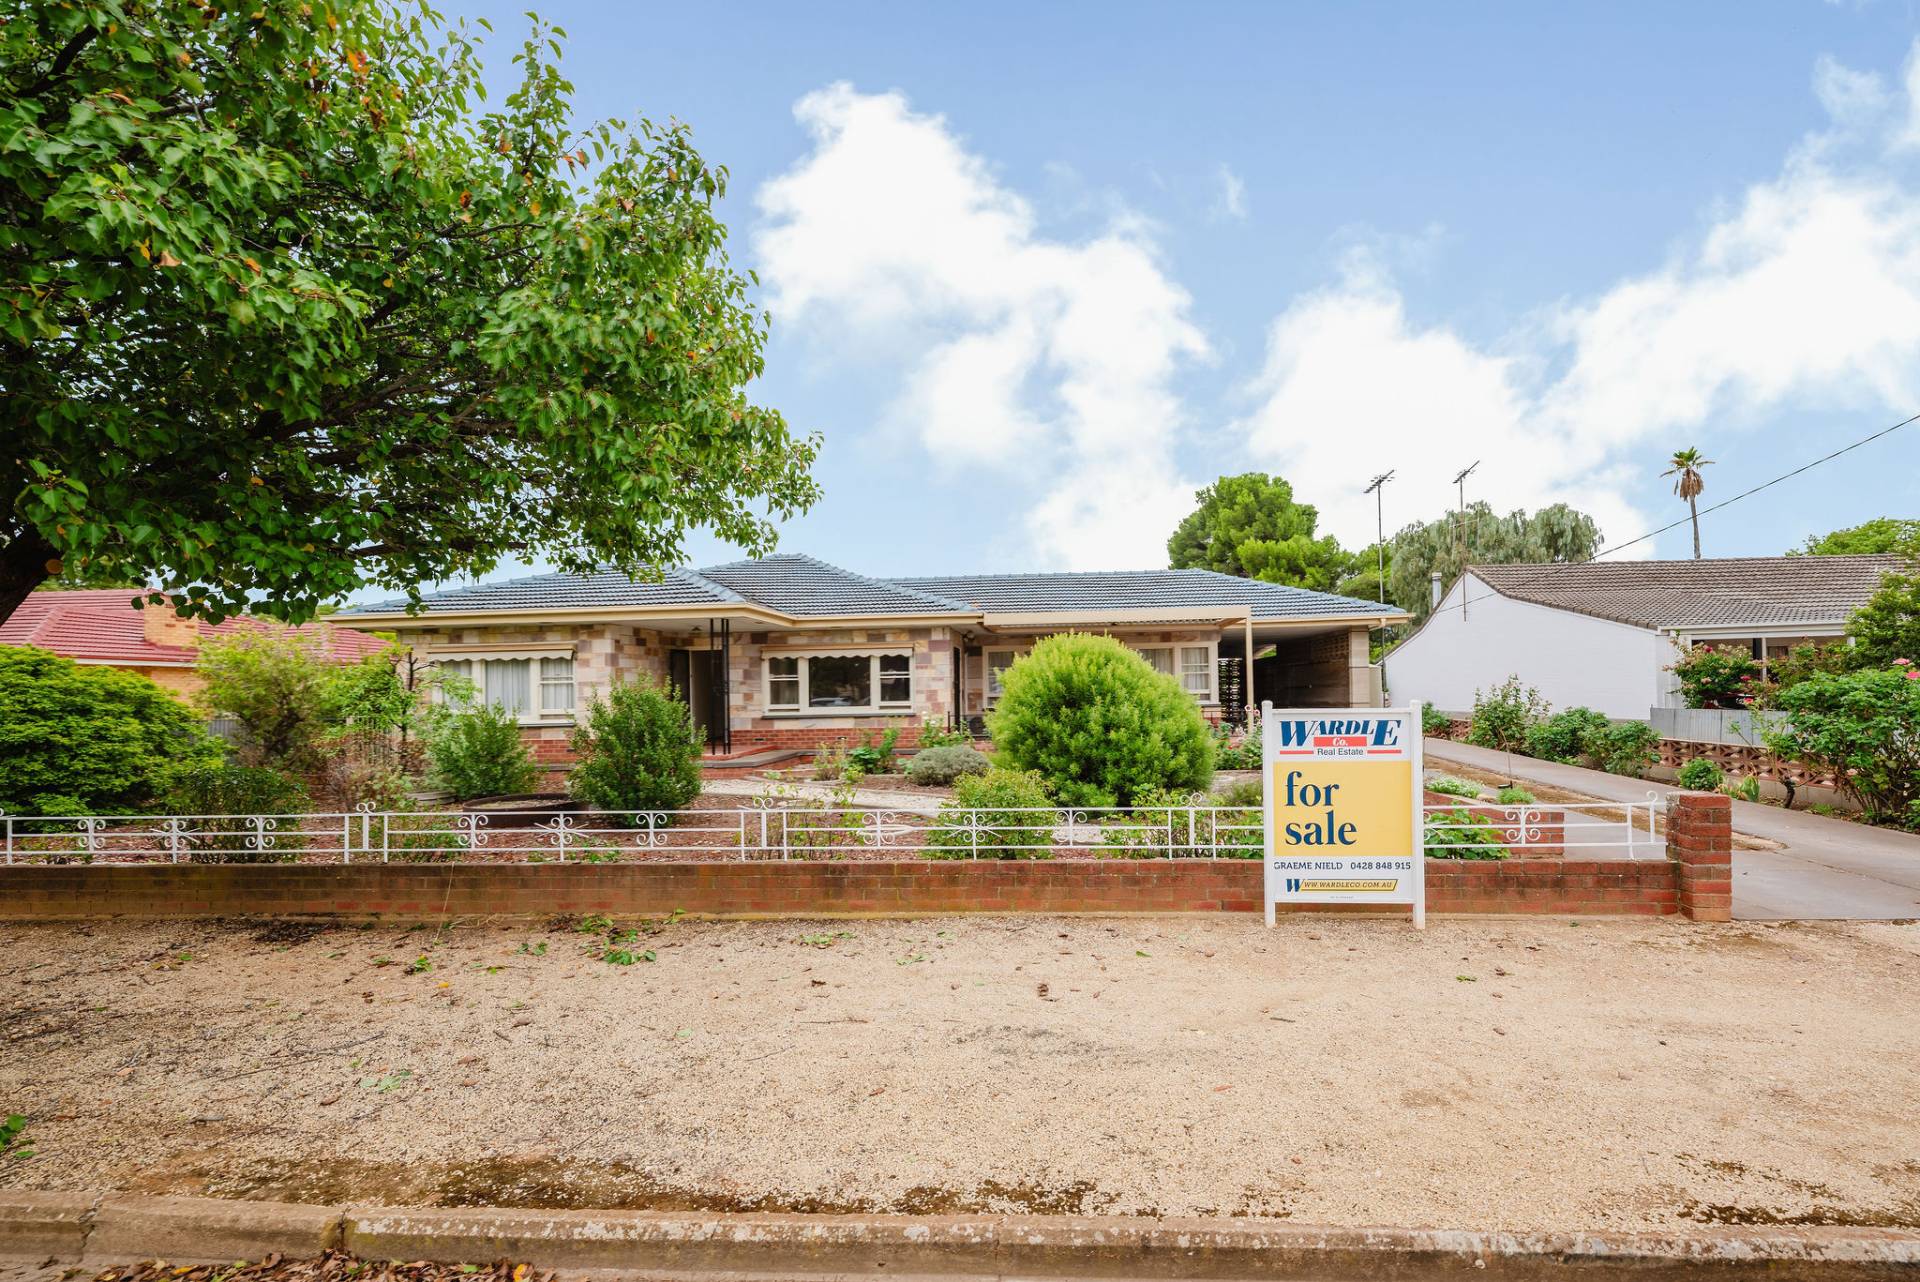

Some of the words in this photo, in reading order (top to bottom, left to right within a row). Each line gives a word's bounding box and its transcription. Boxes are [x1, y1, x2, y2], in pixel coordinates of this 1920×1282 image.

[1280, 720, 1401, 746] WARDLE
[1332, 737, 1348, 746] Co.
[1317, 748, 1336, 756] Real
[1338, 748, 1364, 756] Estate
[1285, 771, 1340, 807] for
[1285, 809, 1357, 846] sale
[1274, 862, 1312, 870] GRAEME
[1315, 862, 1343, 870] NIELD
[1350, 862, 1373, 870] 0428
[1375, 862, 1393, 870] 848
[1395, 862, 1411, 870] 915
